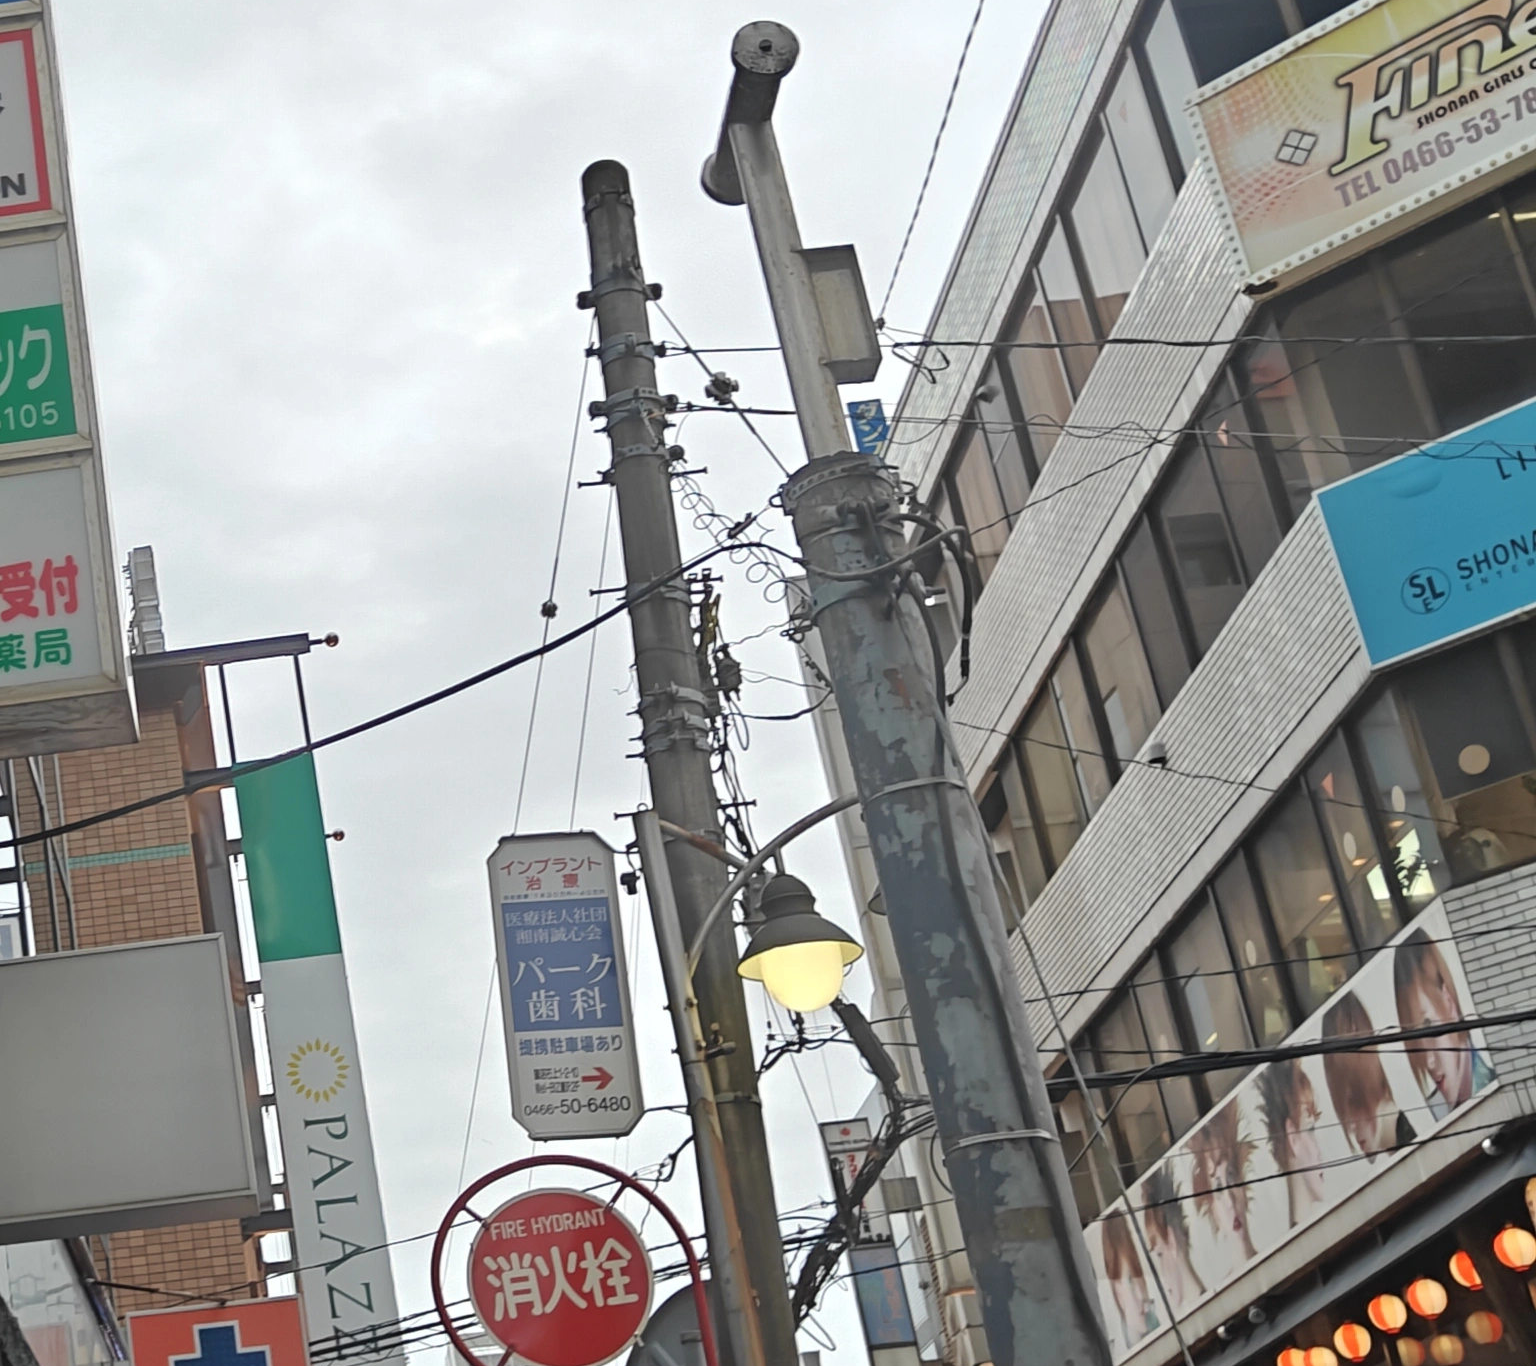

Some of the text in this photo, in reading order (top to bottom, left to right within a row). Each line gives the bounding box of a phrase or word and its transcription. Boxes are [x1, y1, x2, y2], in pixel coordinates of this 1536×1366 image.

[1416, 64, 1526, 129] SHONAN GIRLS
[1334, 170, 1382, 208] TEL
[1456, 529, 1536, 580] SHON
[504, 906, 608, 928] 医療法人社団
[513, 953, 613, 986] パーク
[525, 986, 607, 1023] 歯科
[519, 1034, 623, 1056] 提携駐車場あり
[523, 1095, 631, 1116] 0466-50-6480
[490, 1208, 606, 1241] FIRE HYDRANT
[483, 1237, 640, 1323] 消火栓
